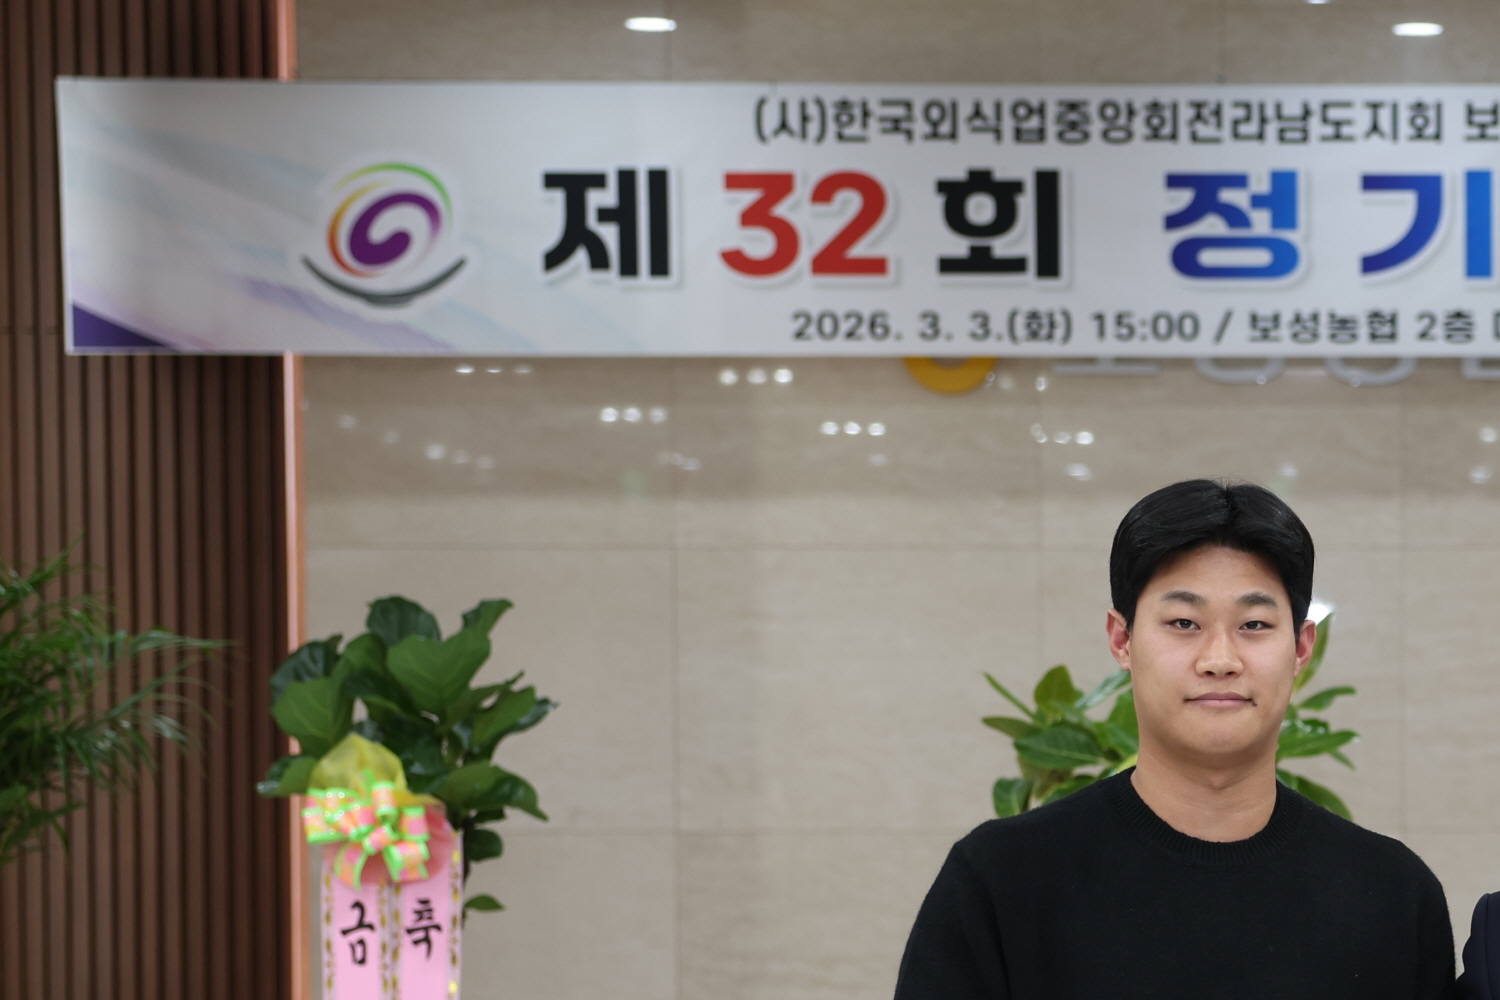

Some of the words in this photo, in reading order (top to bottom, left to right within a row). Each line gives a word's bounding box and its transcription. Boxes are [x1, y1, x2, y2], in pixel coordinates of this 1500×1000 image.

[755, 97, 1443, 145] (사)한국외식업중앙회전라남도지회
[793, 311, 903, 341] 2026.
[1092, 312, 1200, 341] 15:00
[1249, 311, 1398, 343] 보성농협
[1417, 310, 1474, 342] 2층
[405, 897, 443, 962] 축
